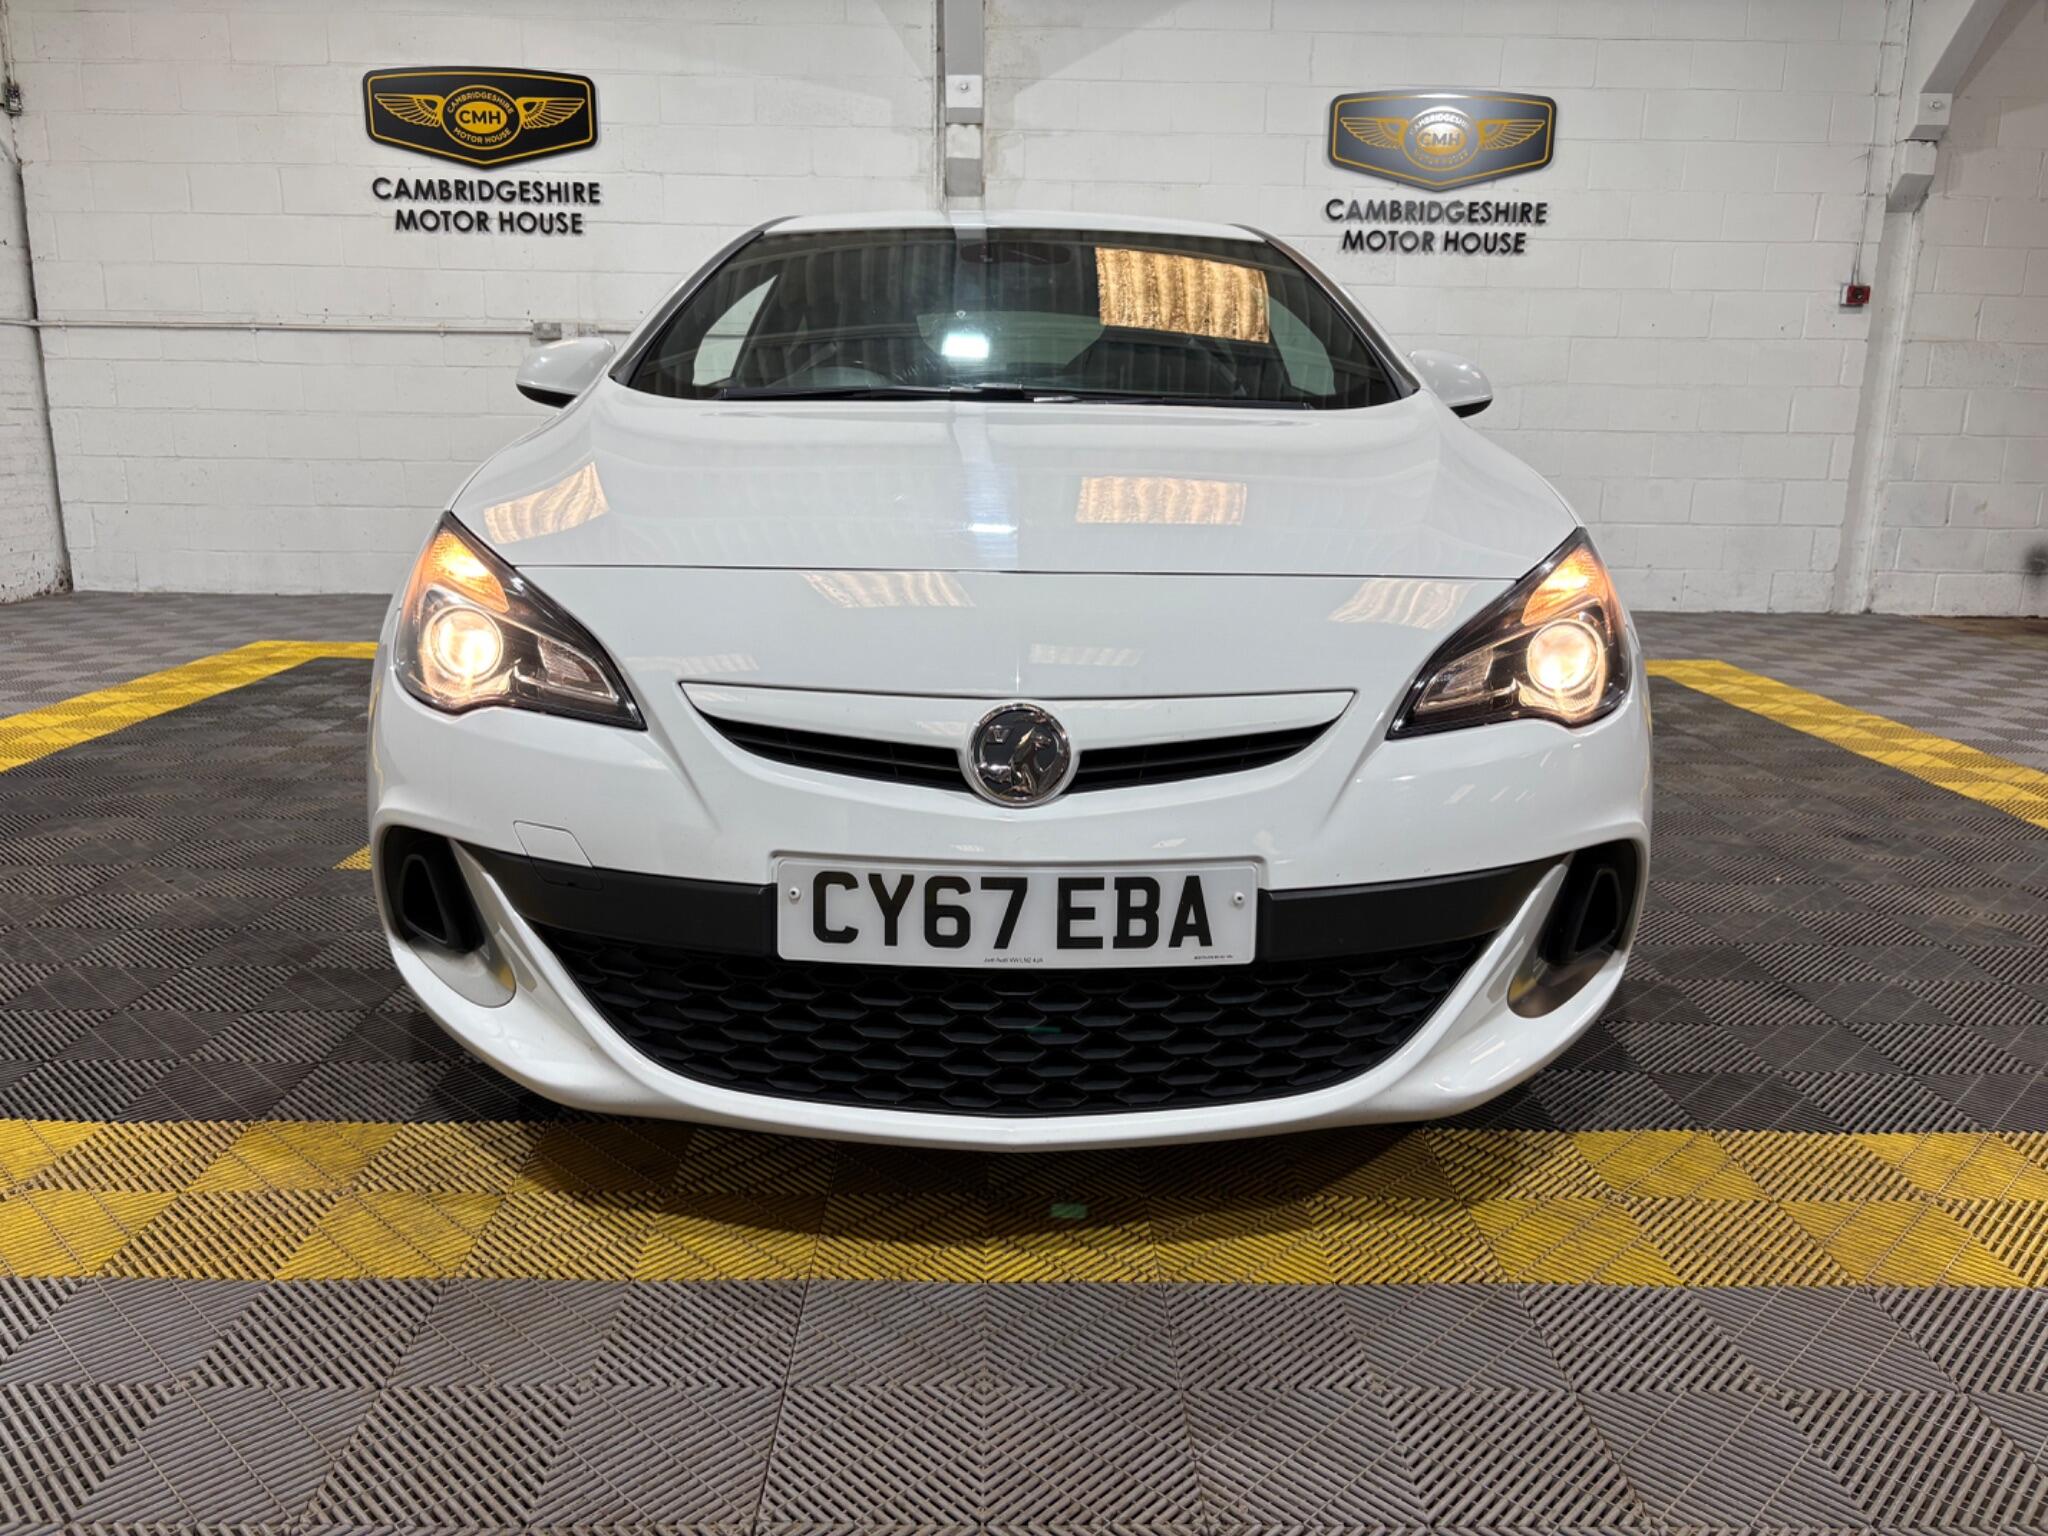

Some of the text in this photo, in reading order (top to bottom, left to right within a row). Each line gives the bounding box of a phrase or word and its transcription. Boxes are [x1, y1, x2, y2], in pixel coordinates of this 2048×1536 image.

[447, 91, 514, 113] CAMBRIDGESHIRE
[459, 110, 501, 124] CMH
[453, 127, 511, 144] MOTOR HOUSE
[1420, 132, 1460, 146] CMH
[372, 177, 600, 204] CAMBRIDGESHIRE
[396, 209, 583, 234] MOTOR HOUSE
[1326, 198, 1548, 224] CAMBRIDGESHIRE
[1342, 230, 1526, 253] MOTOR HOUSE
[812, 870, 1213, 949] CY67 EBA
